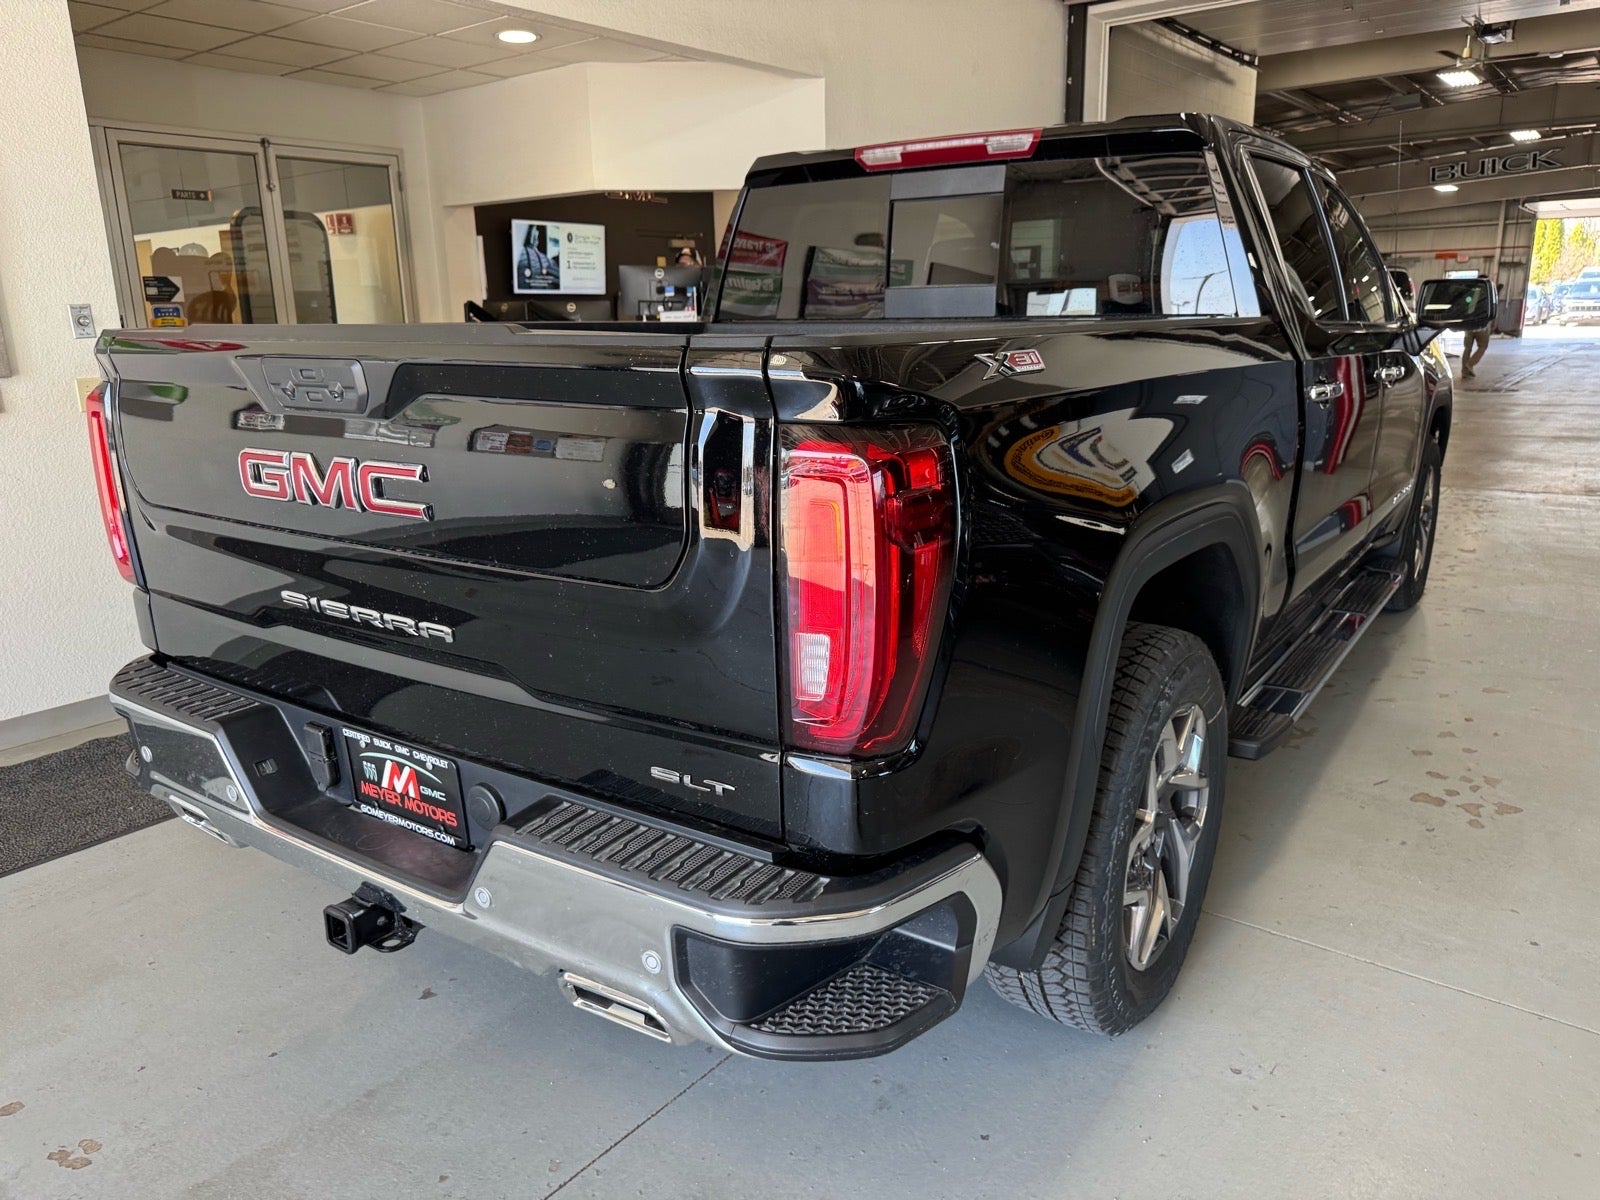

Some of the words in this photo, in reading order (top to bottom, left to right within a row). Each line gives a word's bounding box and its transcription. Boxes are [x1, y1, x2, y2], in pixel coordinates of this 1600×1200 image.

[1429, 148, 1561, 183] BUICK
[175, 190, 196, 200] PARTS
[974, 350, 1043, 380] X31
[238, 447, 434, 522] GMC
[280, 590, 455, 644] SIERRA
[343, 729, 371, 742] CERTIFIED
[373, 738, 392, 750] BUICK
[395, 745, 410, 756] GMC
[413, 752, 448, 768] CHEVROLET
[420, 785, 446, 801] GMC
[650, 766, 736, 796] SLT
[361, 781, 402, 806] MEYER
[405, 797, 457, 826] MOTORS
[361, 804, 456, 846] GOMEYERMOTORS.COM
